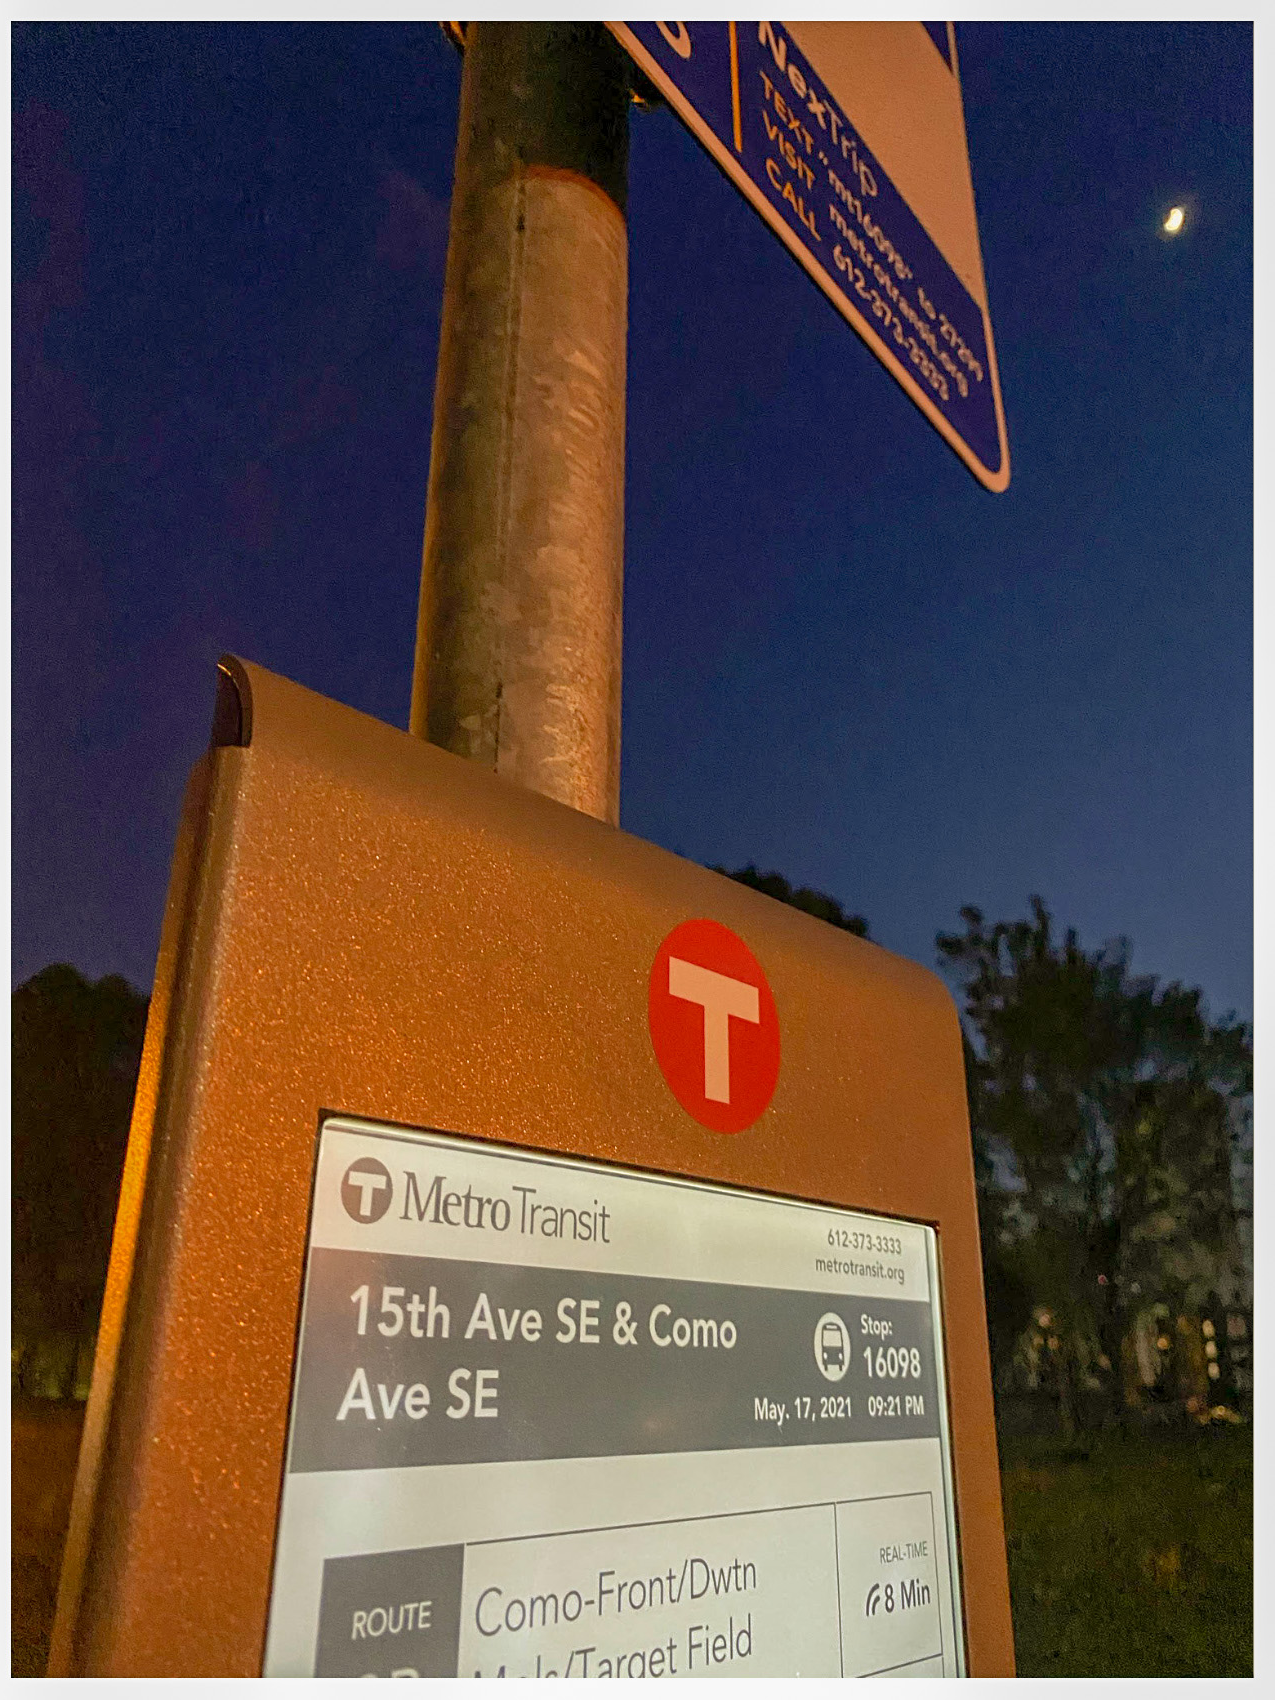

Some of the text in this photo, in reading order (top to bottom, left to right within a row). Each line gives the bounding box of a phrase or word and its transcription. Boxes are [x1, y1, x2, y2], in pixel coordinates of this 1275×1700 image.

[758, 21, 878, 197] NexTrip
[759, 70, 814, 155] TEXT
[762, 109, 816, 190] VISIT
[765, 157, 822, 241] CALL
[669, 955, 760, 1105] T
[827, 1228, 902, 1255] 612-373-3333
[815, 1256, 905, 1286] metrotransit.org
[350, 1284, 737, 1349] 15th Ave SE & Como
[860, 1313, 893, 1341] Stop:
[863, 1346, 922, 1379] 16098
[335, 1367, 500, 1421] Ave SE
[754, 1396, 852, 1426] May. 17, 2021
[868, 1394, 925, 1417] 09:21 PM
[879, 1541, 929, 1564] REAL-TIME
[475, 1557, 757, 1638] Como-Front/Dwtn
[884, 1578, 931, 1614] 8 Min
[350, 1600, 433, 1641] ROUTE
[474, 1612, 754, 1678] /Target Field
